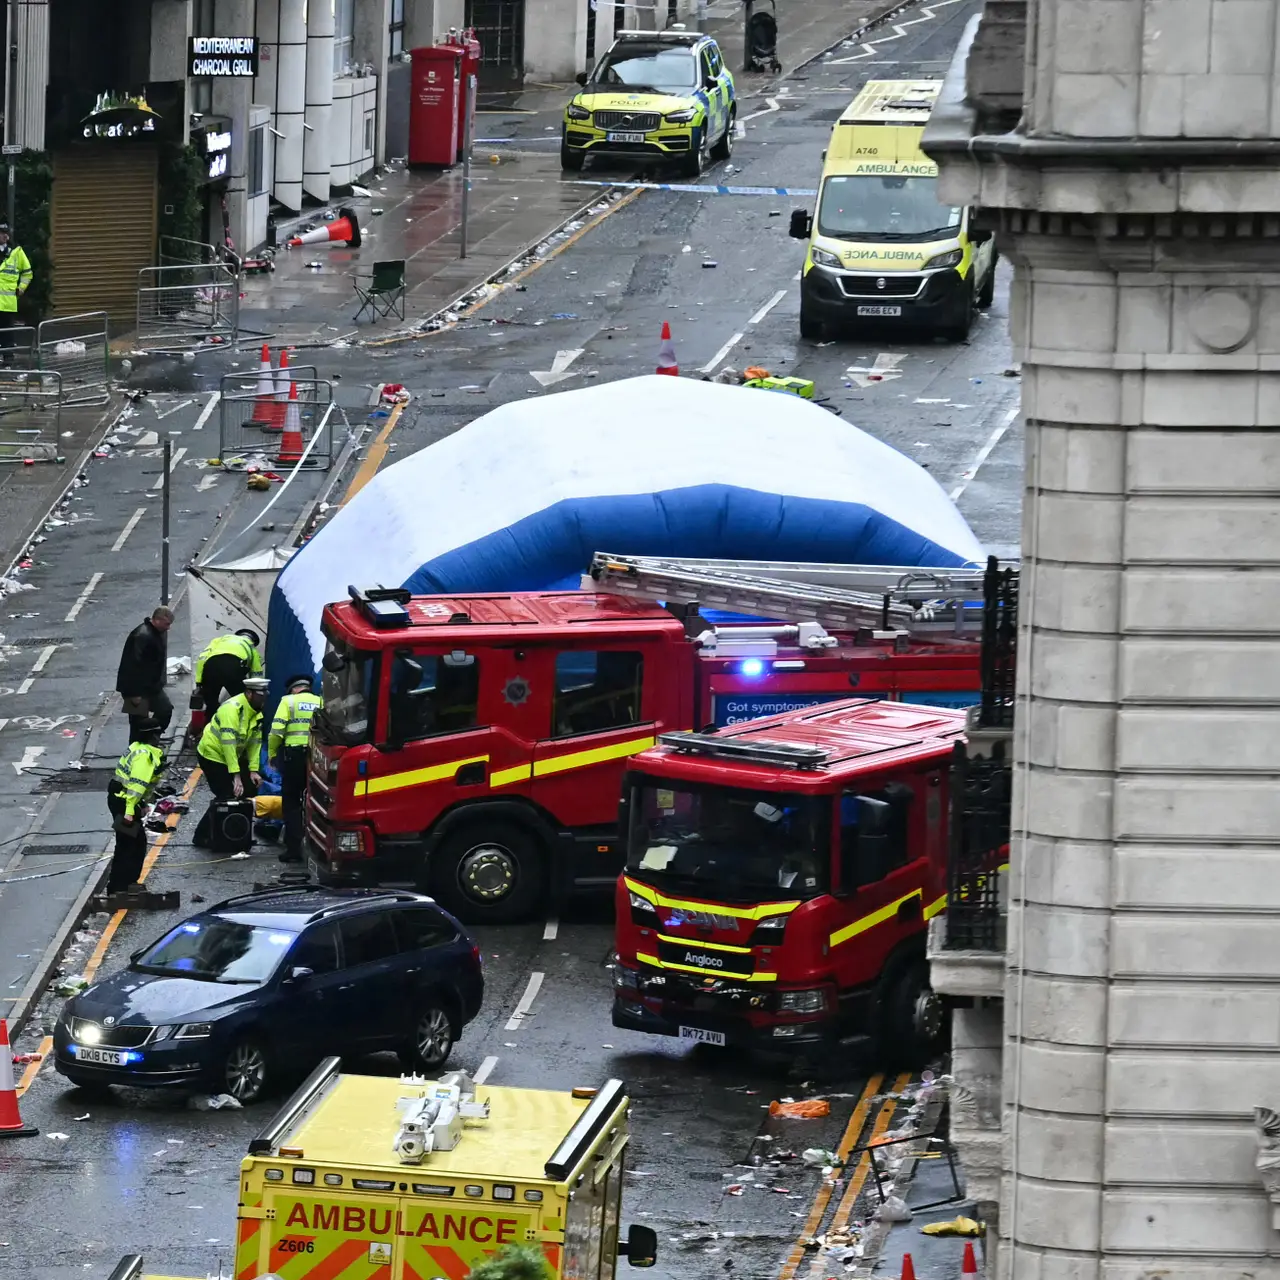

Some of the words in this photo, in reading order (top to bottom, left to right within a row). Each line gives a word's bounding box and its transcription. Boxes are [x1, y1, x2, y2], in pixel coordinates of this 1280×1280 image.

[193, 37, 254, 54] MEDITERRANEAN
[192, 59, 232, 75] CHARCOAL
[233, 59, 254, 75] GRILL
[856, 147, 878, 155] A740
[856, 164, 938, 175] AMBULANCE
[727, 702, 749, 712] Got
[685, 951, 723, 968] Angloco
[682, 1027, 704, 1041] DK72
[705, 1031, 722, 1043] AVU
[80, 1049, 100, 1060] DK18
[101, 1051, 120, 1064] CYS
[285, 1202, 517, 1244] AMBULANCE
[278, 1239, 315, 1254] Z606
